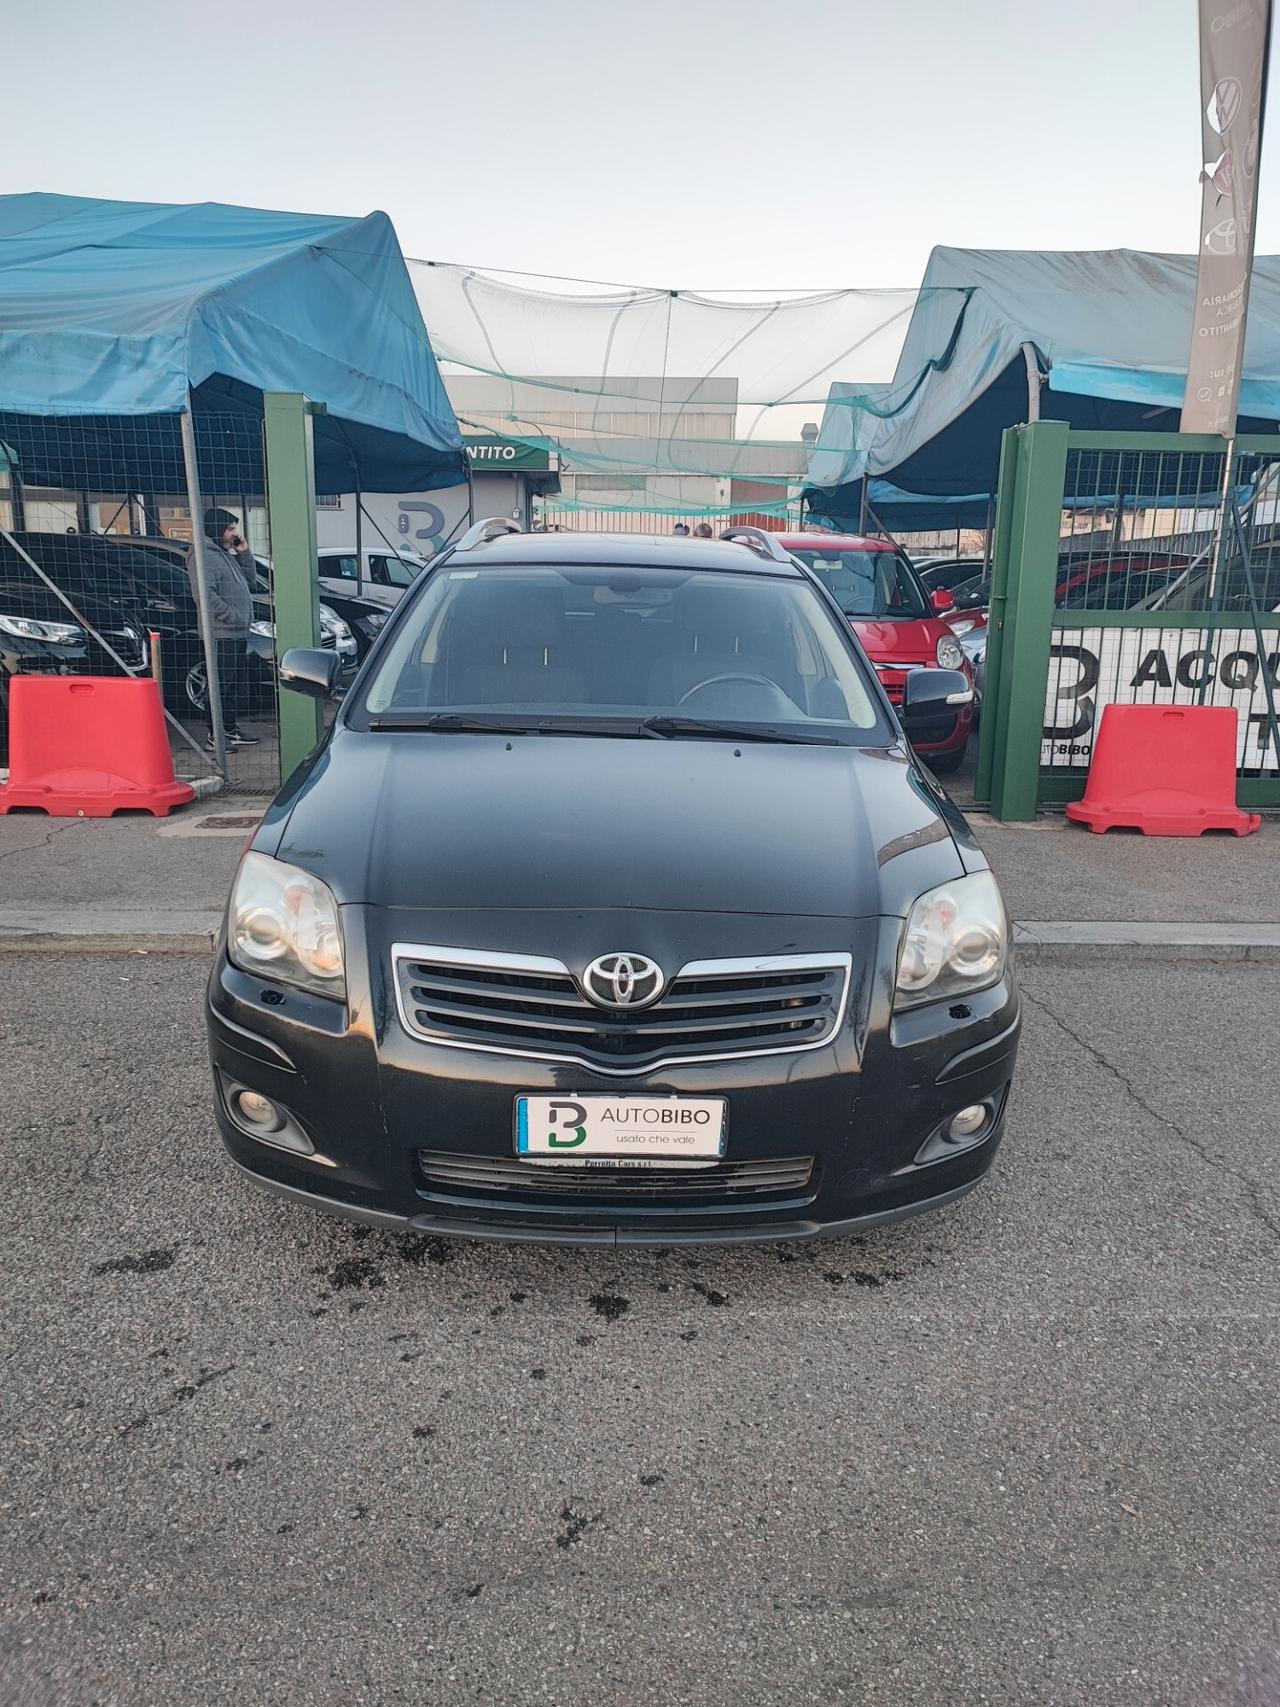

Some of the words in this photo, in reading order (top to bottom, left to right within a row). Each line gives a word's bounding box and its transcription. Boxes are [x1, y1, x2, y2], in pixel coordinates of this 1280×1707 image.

[600, 1108, 710, 1125] AUTOBIBO
[616, 1135, 646, 1144] usato
[648, 1135, 670, 1145] che
[672, 1135, 696, 1145] vale
[618, 1159, 636, 1168] Cars
